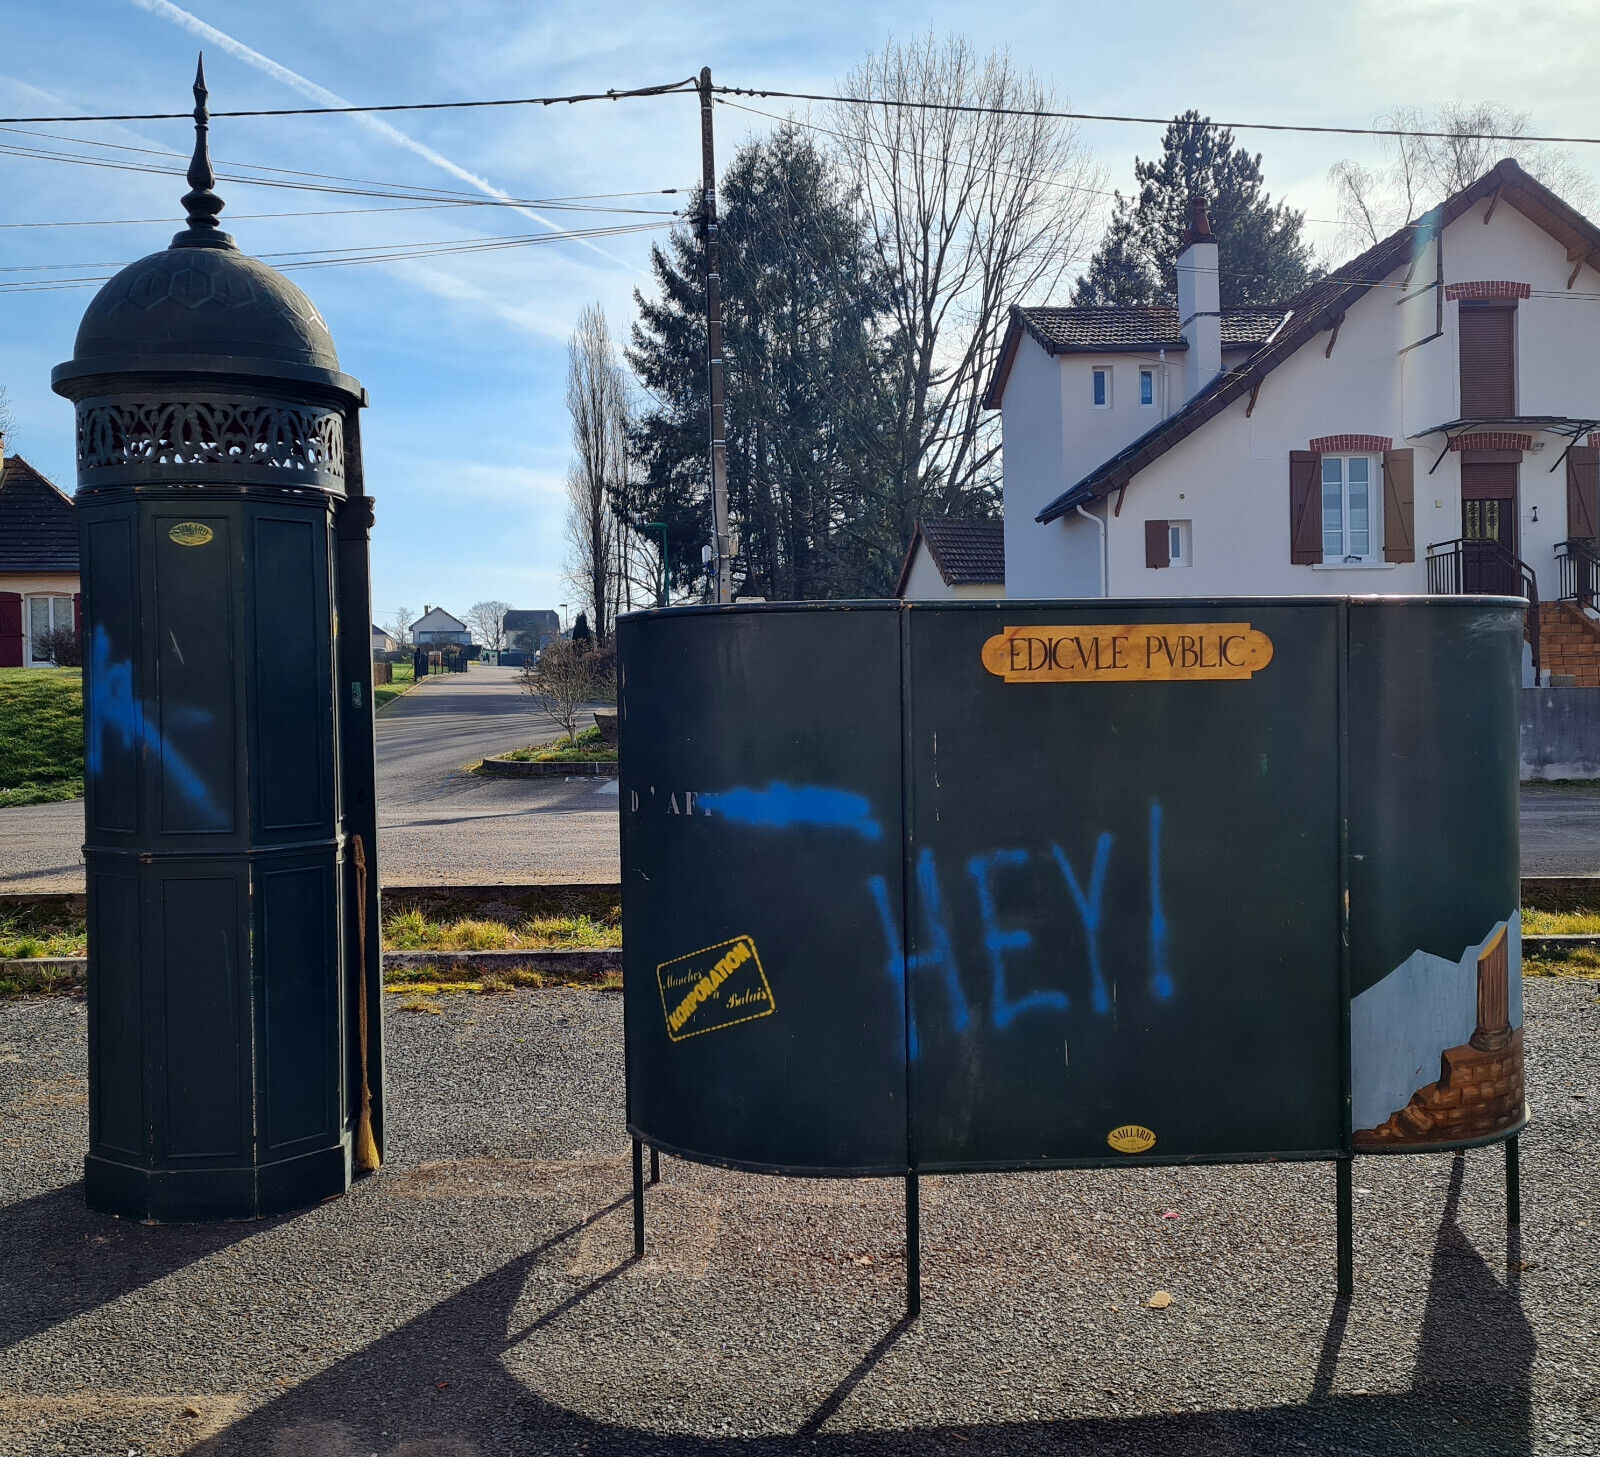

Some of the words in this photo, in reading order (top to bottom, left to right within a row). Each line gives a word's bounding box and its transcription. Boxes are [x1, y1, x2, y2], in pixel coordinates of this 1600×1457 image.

[1009, 636, 1129, 671] EDICVLE
[1146, 635, 1246, 669] PVBLIC
[869, 800, 1175, 1064] HEY!
